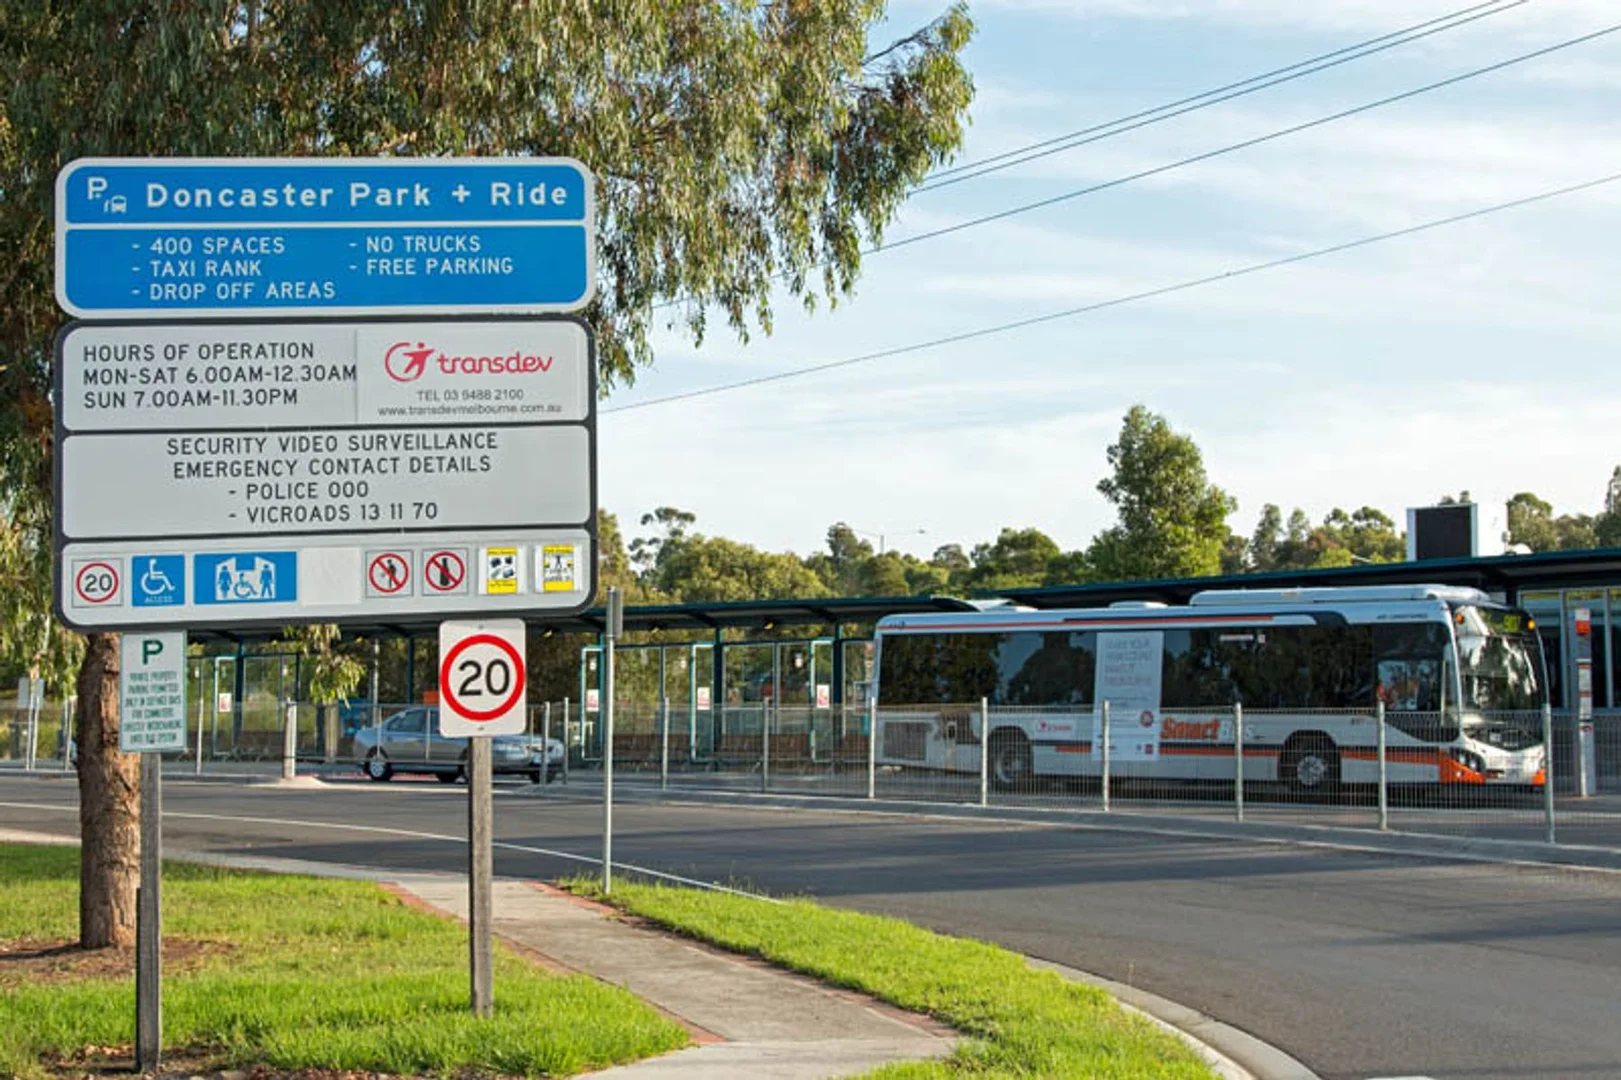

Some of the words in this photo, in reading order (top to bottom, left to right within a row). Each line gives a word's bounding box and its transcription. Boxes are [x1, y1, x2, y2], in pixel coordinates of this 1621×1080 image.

[88, 177, 107, 199] P
[147, 183, 333, 207] Doncaster
[351, 183, 429, 206] Park
[452, 185, 470, 202] +
[492, 182, 566, 205] Ride
[151, 237, 191, 254] 400
[203, 237, 284, 254] SPACES
[367, 236, 392, 252] NO
[404, 235, 480, 252] TRUCKS
[151, 260, 195, 276] TAXI
[206, 260, 260, 276] RANK
[367, 258, 415, 275] FREE
[426, 257, 512, 274] PARKING
[151, 283, 205, 300] DROP
[217, 282, 254, 299] OFF
[266, 282, 335, 298] AREAS
[84, 345, 154, 362] HOURS
[164, 344, 189, 360] OF
[199, 343, 313, 360] OPERATION
[437, 352, 552, 374] transdev
[84, 367, 177, 385] MON-SAT
[186, 364, 357, 384] 6.00AM-12.30AM
[85, 392, 125, 408] SUN
[134, 389, 297, 407] 7.00AM-11.30PM
[417, 390, 439, 401] TEL
[444, 389, 458, 400] 03
[495, 389, 523, 400] 2100
[167, 437, 266, 455] SECURITY
[278, 436, 337, 452] VIDEO
[349, 432, 497, 451] SURVEILLANCE
[174, 460, 297, 479] EMERGENCY
[309, 457, 399, 475] CONTACT
[410, 455, 490, 473] DETAILS
[247, 482, 318, 500] POLICE
[329, 481, 368, 498] 000
[247, 505, 350, 523] VICROADS
[361, 504, 380, 520] 13
[391, 503, 402, 519] 11
[413, 503, 437, 519] 70
[85, 573, 112, 593] 20
[143, 640, 163, 664] P
[459, 659, 509, 696] 20
